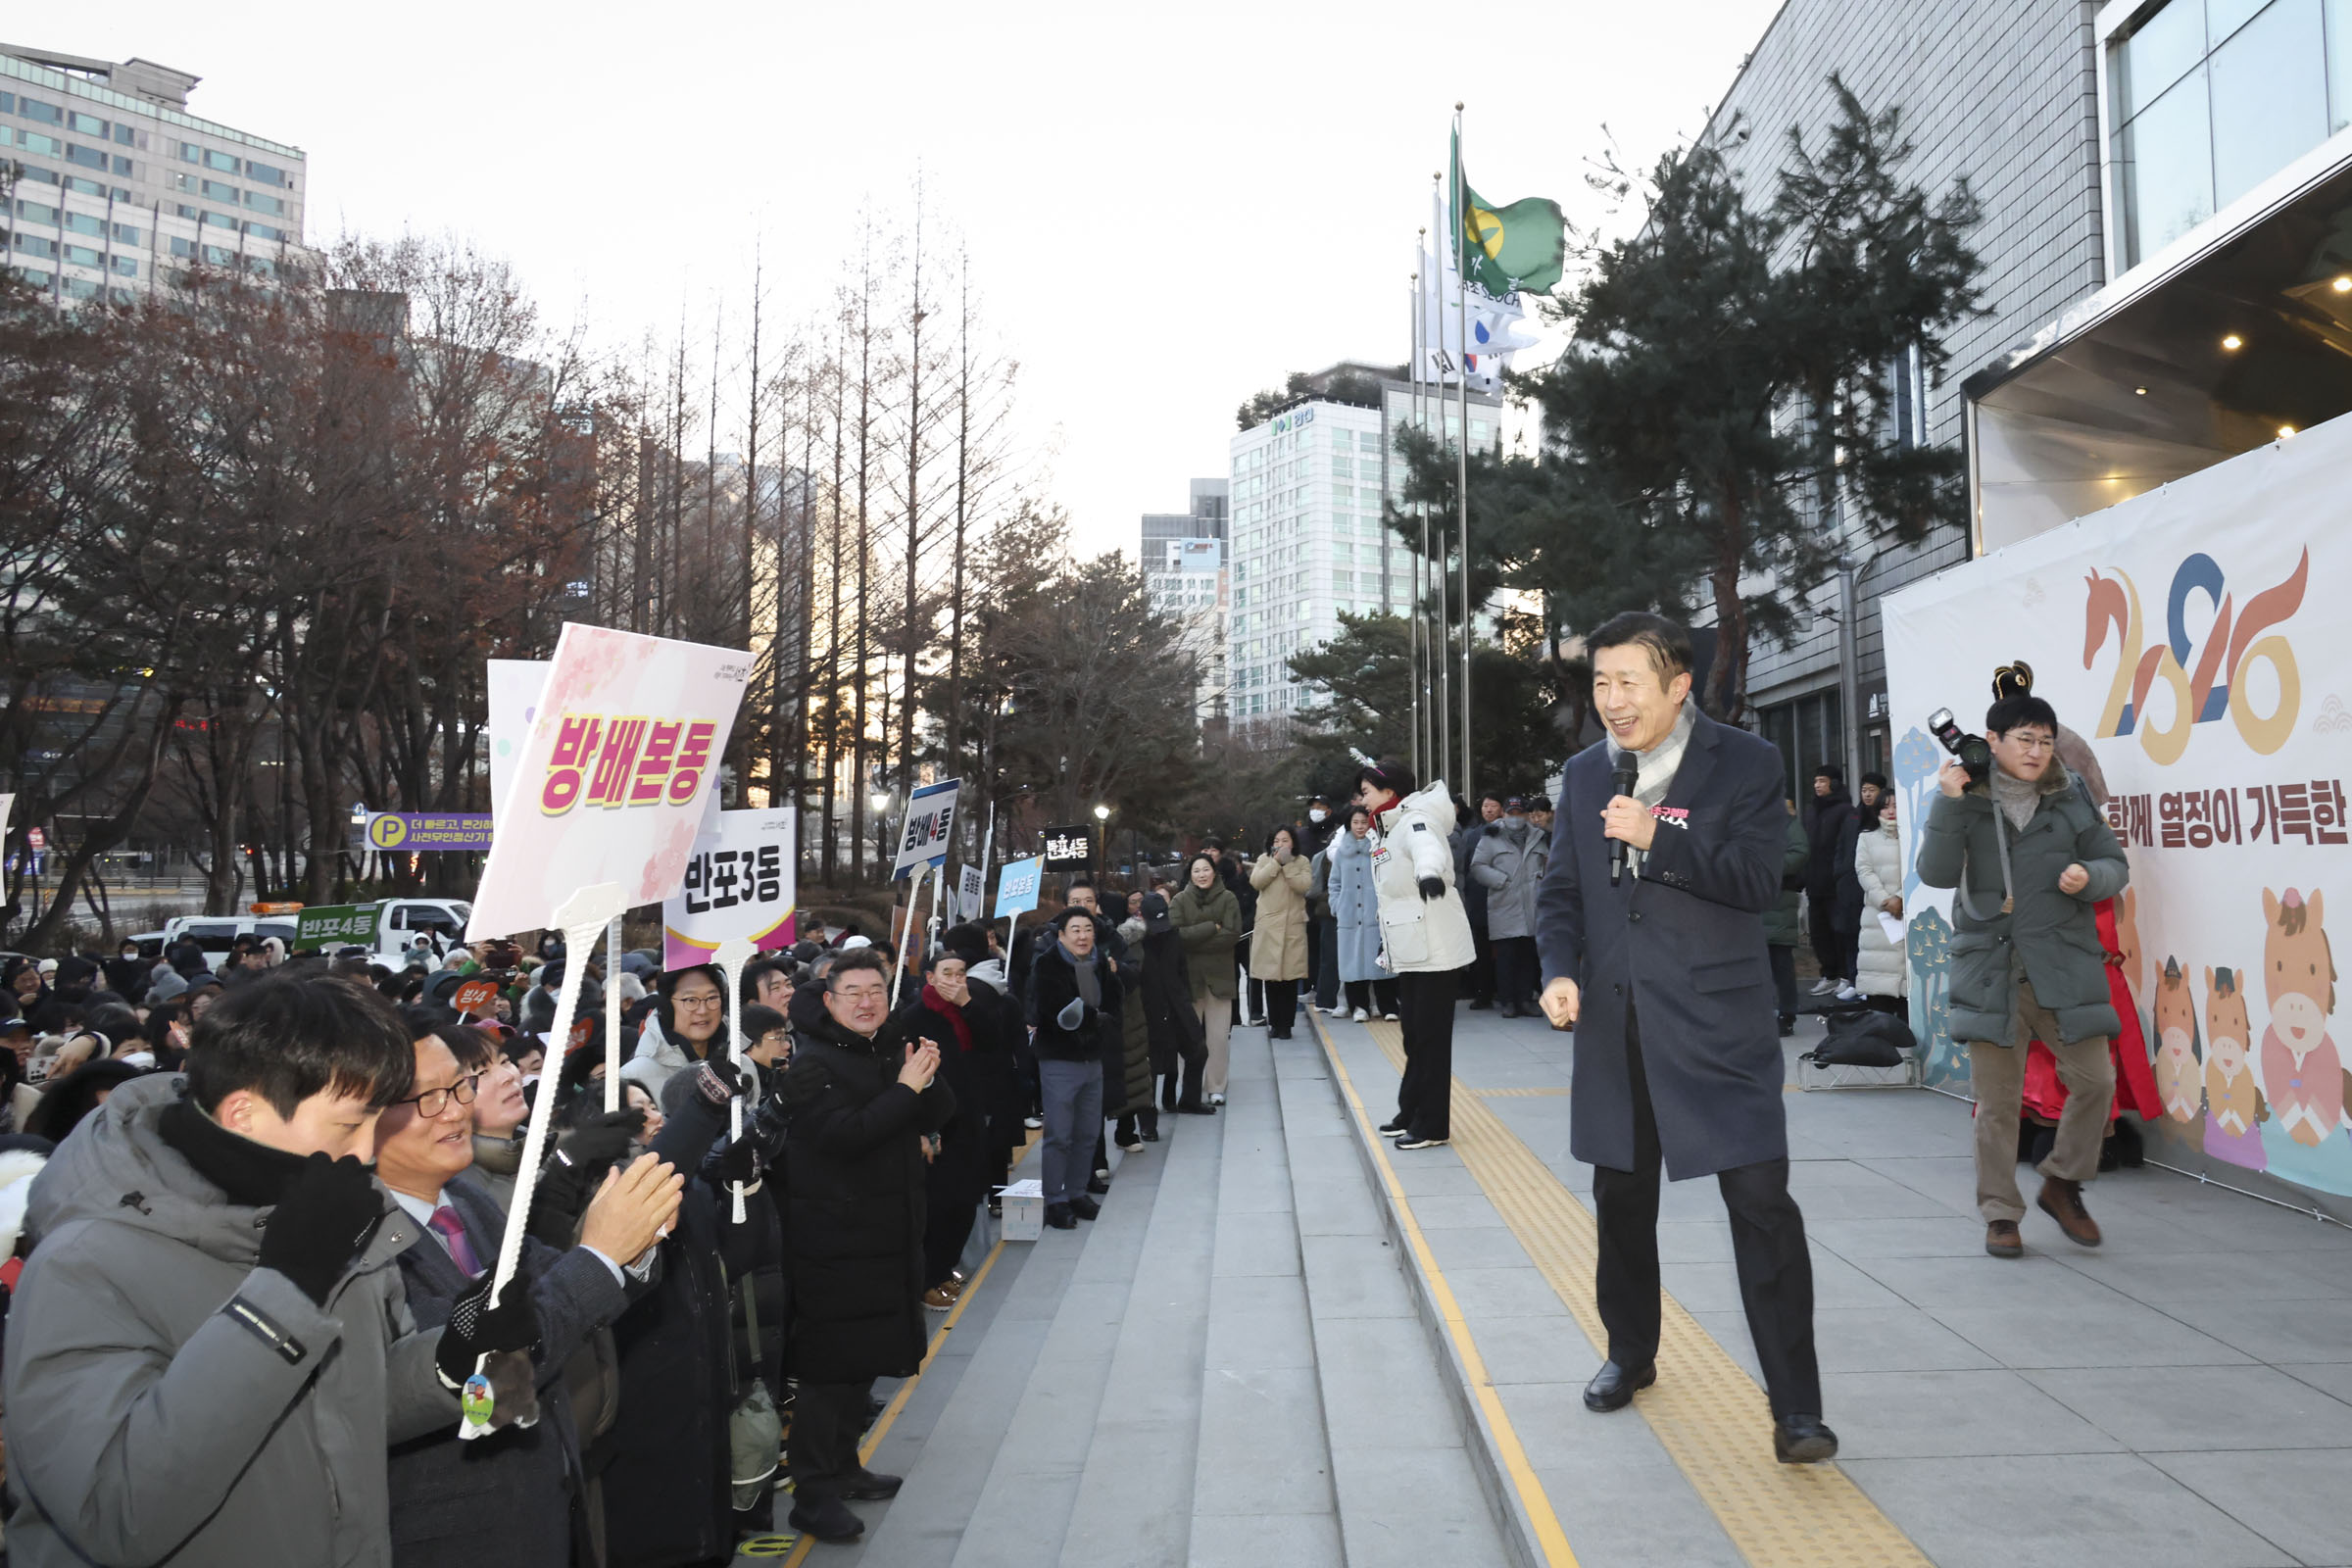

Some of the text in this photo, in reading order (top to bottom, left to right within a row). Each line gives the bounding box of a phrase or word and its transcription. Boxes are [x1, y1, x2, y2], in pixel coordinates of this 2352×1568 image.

[2082, 541, 2309, 766] 2026
[541, 712, 717, 815] 방배본동
[411, 818, 422, 830] 더
[905, 807, 952, 853] 방배4동
[2108, 779, 2349, 849] 함께 열정이 가득한
[684, 845, 781, 915] 반포3동
[1003, 873, 1035, 900] 반포본동
[301, 915, 372, 940] 반포4동
